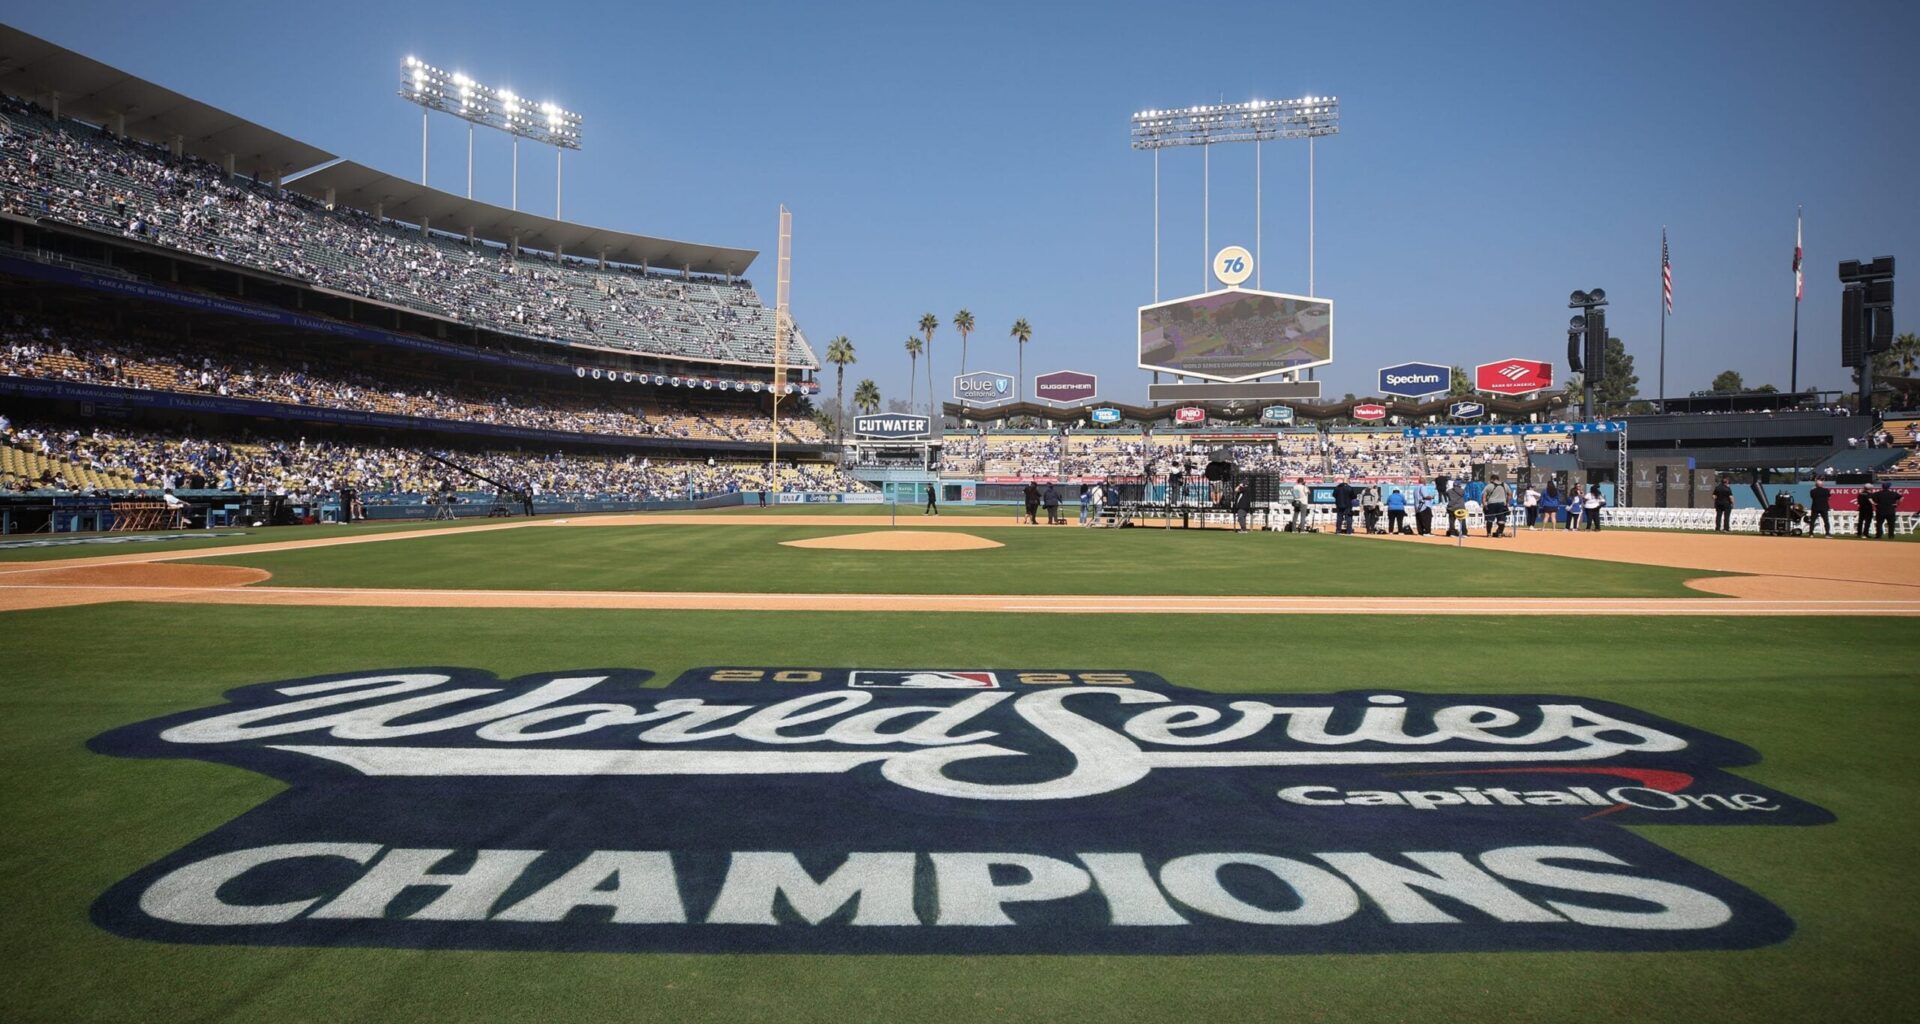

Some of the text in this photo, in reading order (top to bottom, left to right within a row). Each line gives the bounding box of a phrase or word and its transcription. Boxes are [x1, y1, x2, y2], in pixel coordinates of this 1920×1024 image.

[1223, 257, 1244, 273] 76
[959, 378, 992, 391] blue
[1386, 374, 1439, 386] Spectrum
[1181, 410, 1200, 418] JINRO
[858, 419, 924, 432] CUTWATER
[1316, 491, 1336, 500] UCL
[710, 670, 1136, 685] 20 25
[160, 673, 1688, 801] World Series
[138, 842, 1734, 931] CHAMPIONS
